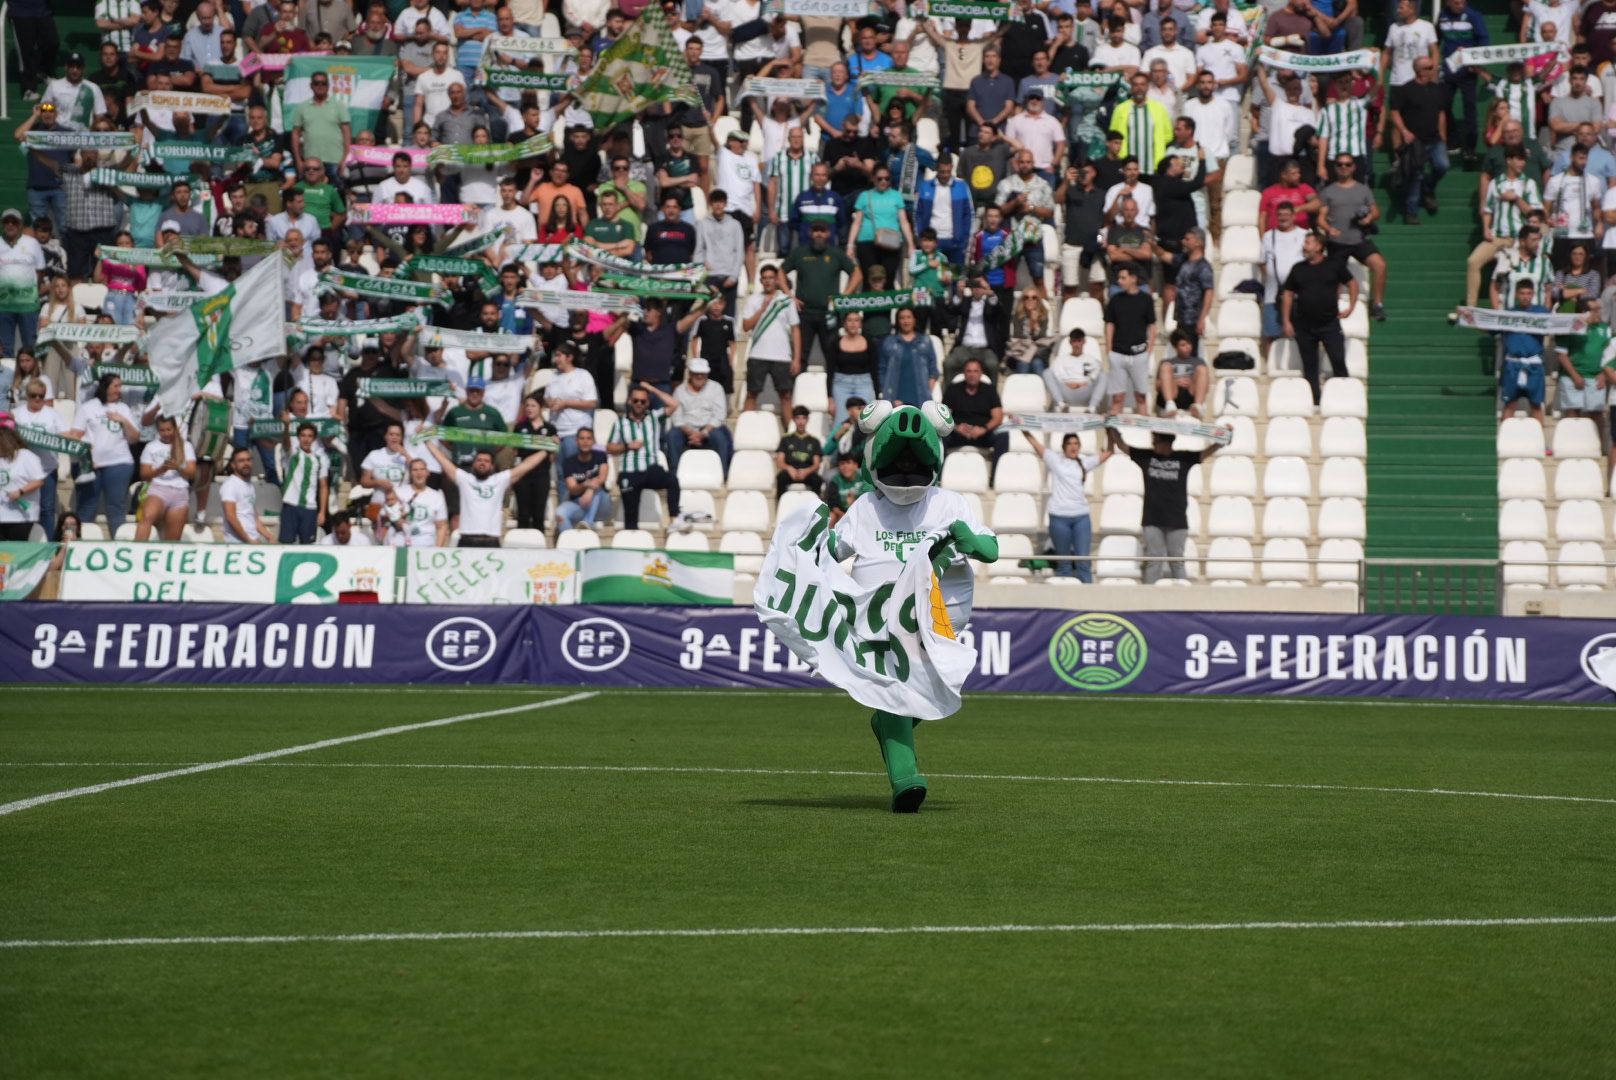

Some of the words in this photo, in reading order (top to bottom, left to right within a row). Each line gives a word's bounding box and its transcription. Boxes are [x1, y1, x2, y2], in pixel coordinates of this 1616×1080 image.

[991, 7, 1007, 16] CF
[550, 77, 565, 87] CF
[152, 95, 181, 106] SOMOS
[182, 96, 193, 107] DE
[894, 293, 910, 304] CF
[876, 530, 893, 541] LOS
[65, 547, 133, 573] LOS
[143, 549, 267, 575] FIELES
[416, 550, 461, 571] LOS
[93, 616, 376, 669] FEDERACIÓN
[1246, 628, 1526, 683] FEDERACIÓN
